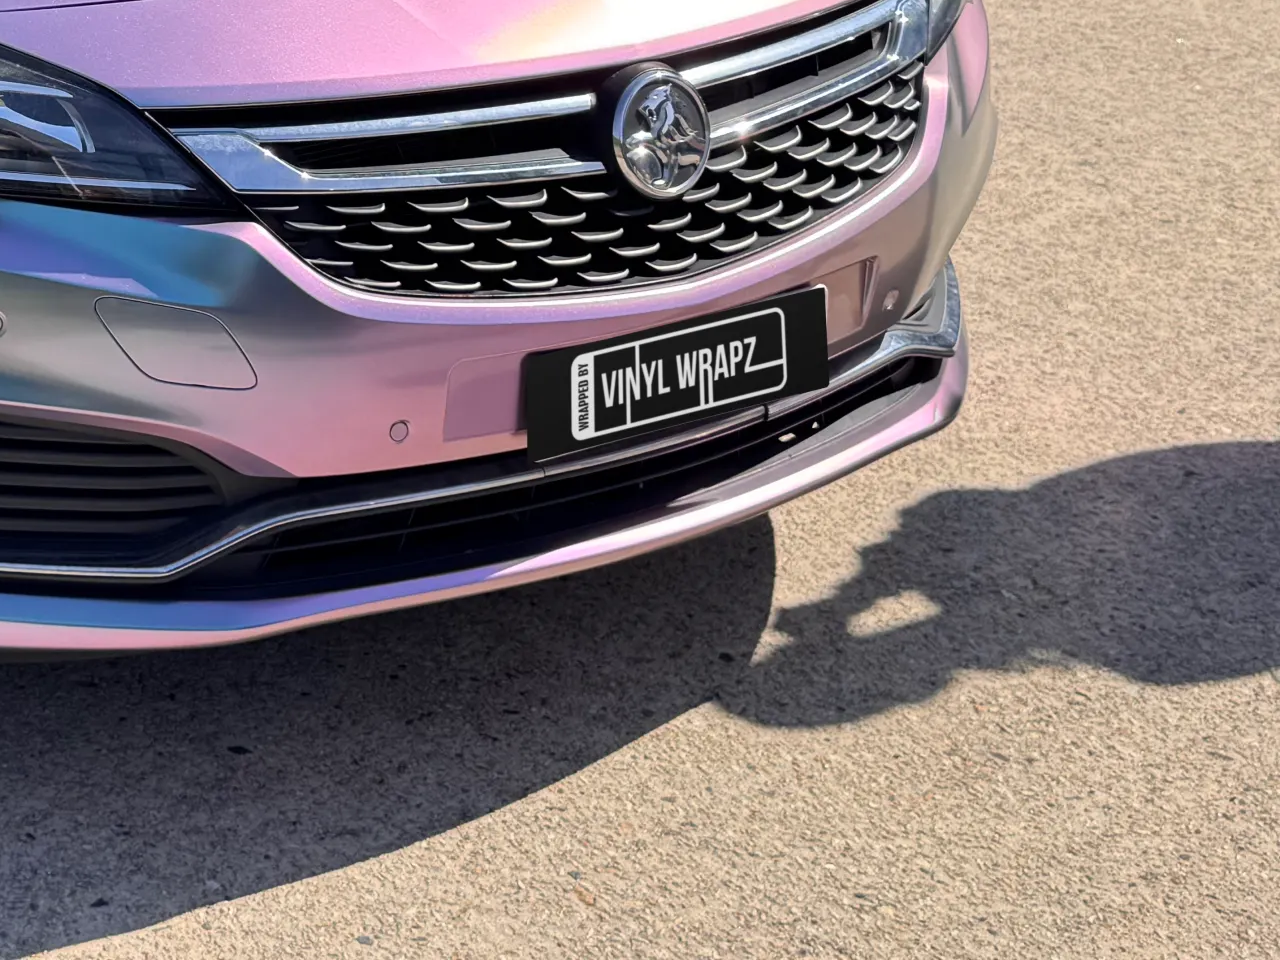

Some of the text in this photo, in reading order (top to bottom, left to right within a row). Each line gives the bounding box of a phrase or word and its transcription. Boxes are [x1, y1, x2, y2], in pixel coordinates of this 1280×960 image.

[577, 363, 590, 432] WRAPPED BY
[601, 335, 766, 413] VINYL WRAPZ
